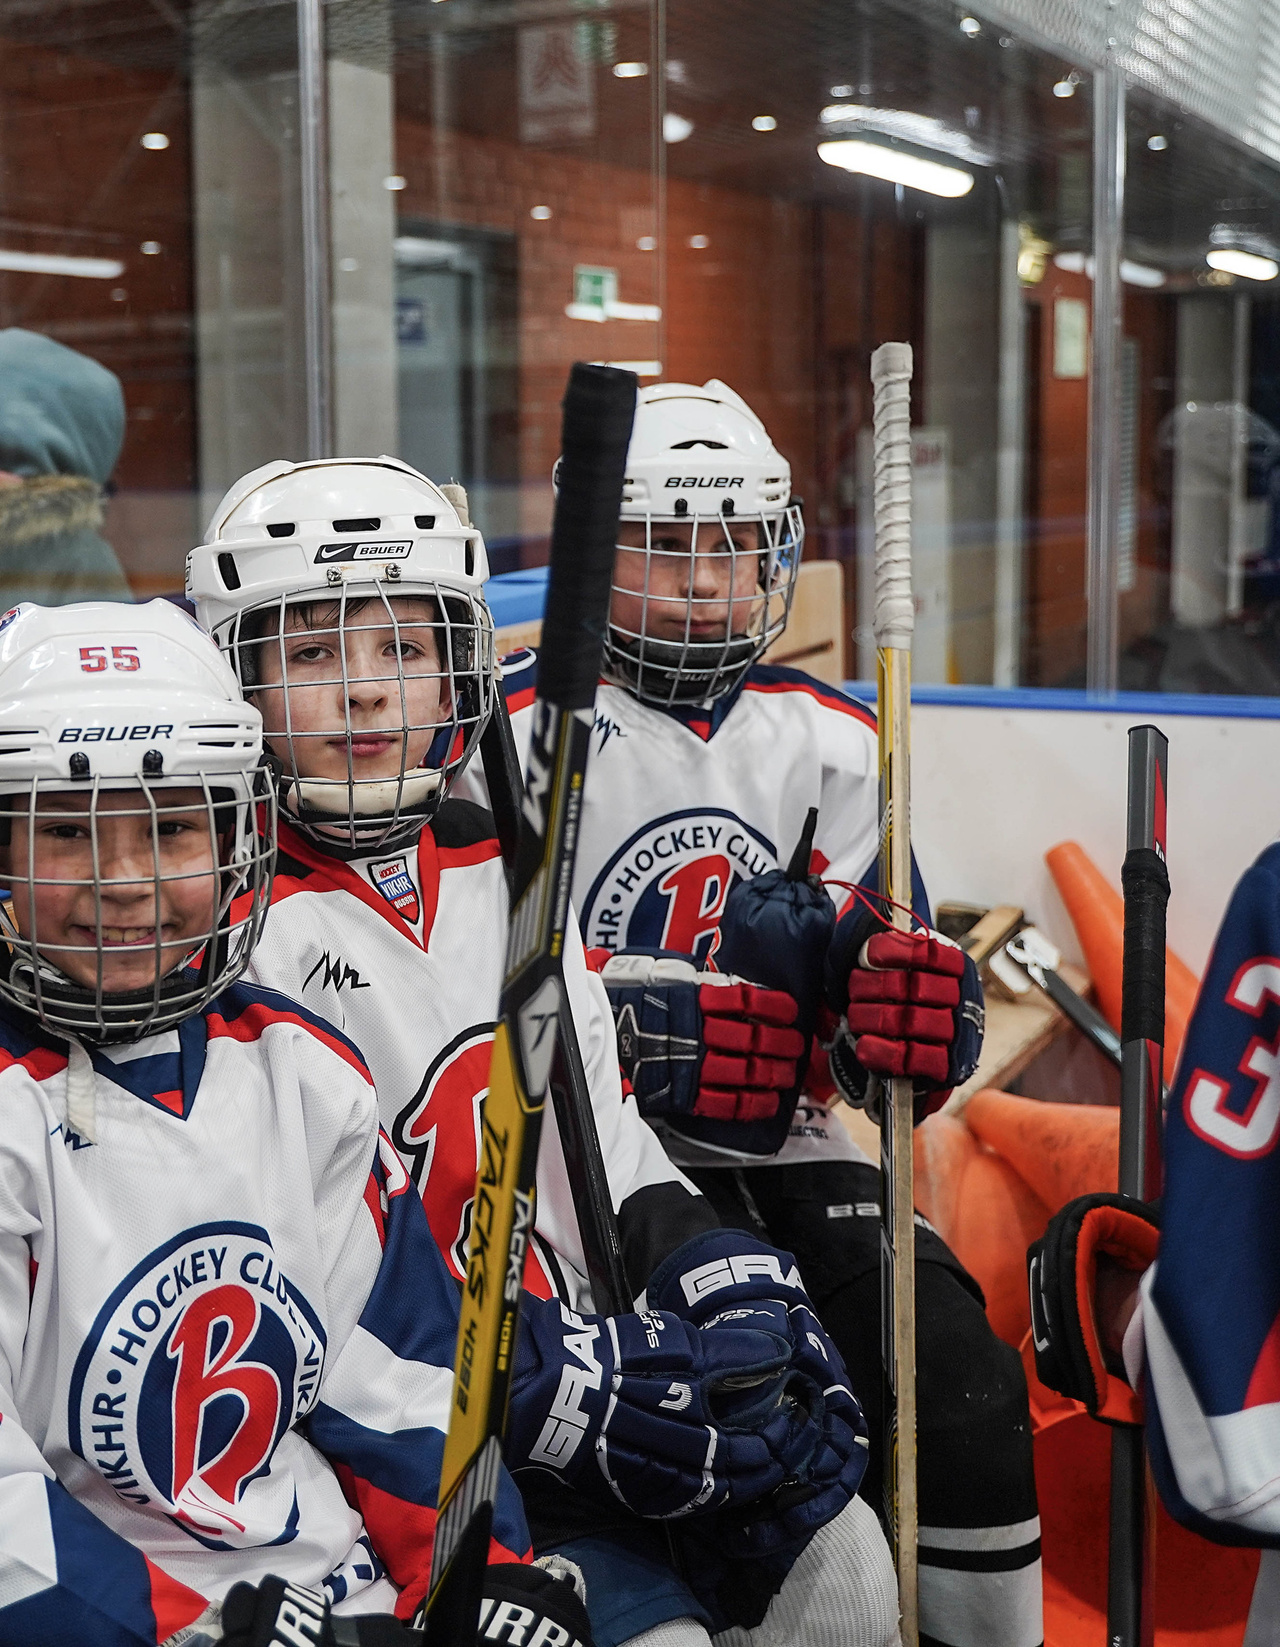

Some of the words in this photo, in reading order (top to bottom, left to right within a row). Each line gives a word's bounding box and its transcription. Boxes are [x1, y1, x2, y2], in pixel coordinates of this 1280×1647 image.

[664, 477, 744, 488] BAUER
[359, 545, 406, 555] BAUER
[79, 646, 141, 673] 55
[58, 724, 174, 744] BAUER
[520, 698, 559, 840] CM
[380, 877, 413, 898] VIKHR
[616, 826, 722, 893] HOCKEY
[726, 834, 767, 876] CLU
[1182, 955, 1280, 1160] 3
[469, 1116, 509, 1312] TACKS
[504, 1186, 535, 1303] TACKS
[110, 1246, 228, 1366] HOCKEY
[680, 1254, 808, 1307] GRA
[528, 1301, 603, 1469] GRAF
